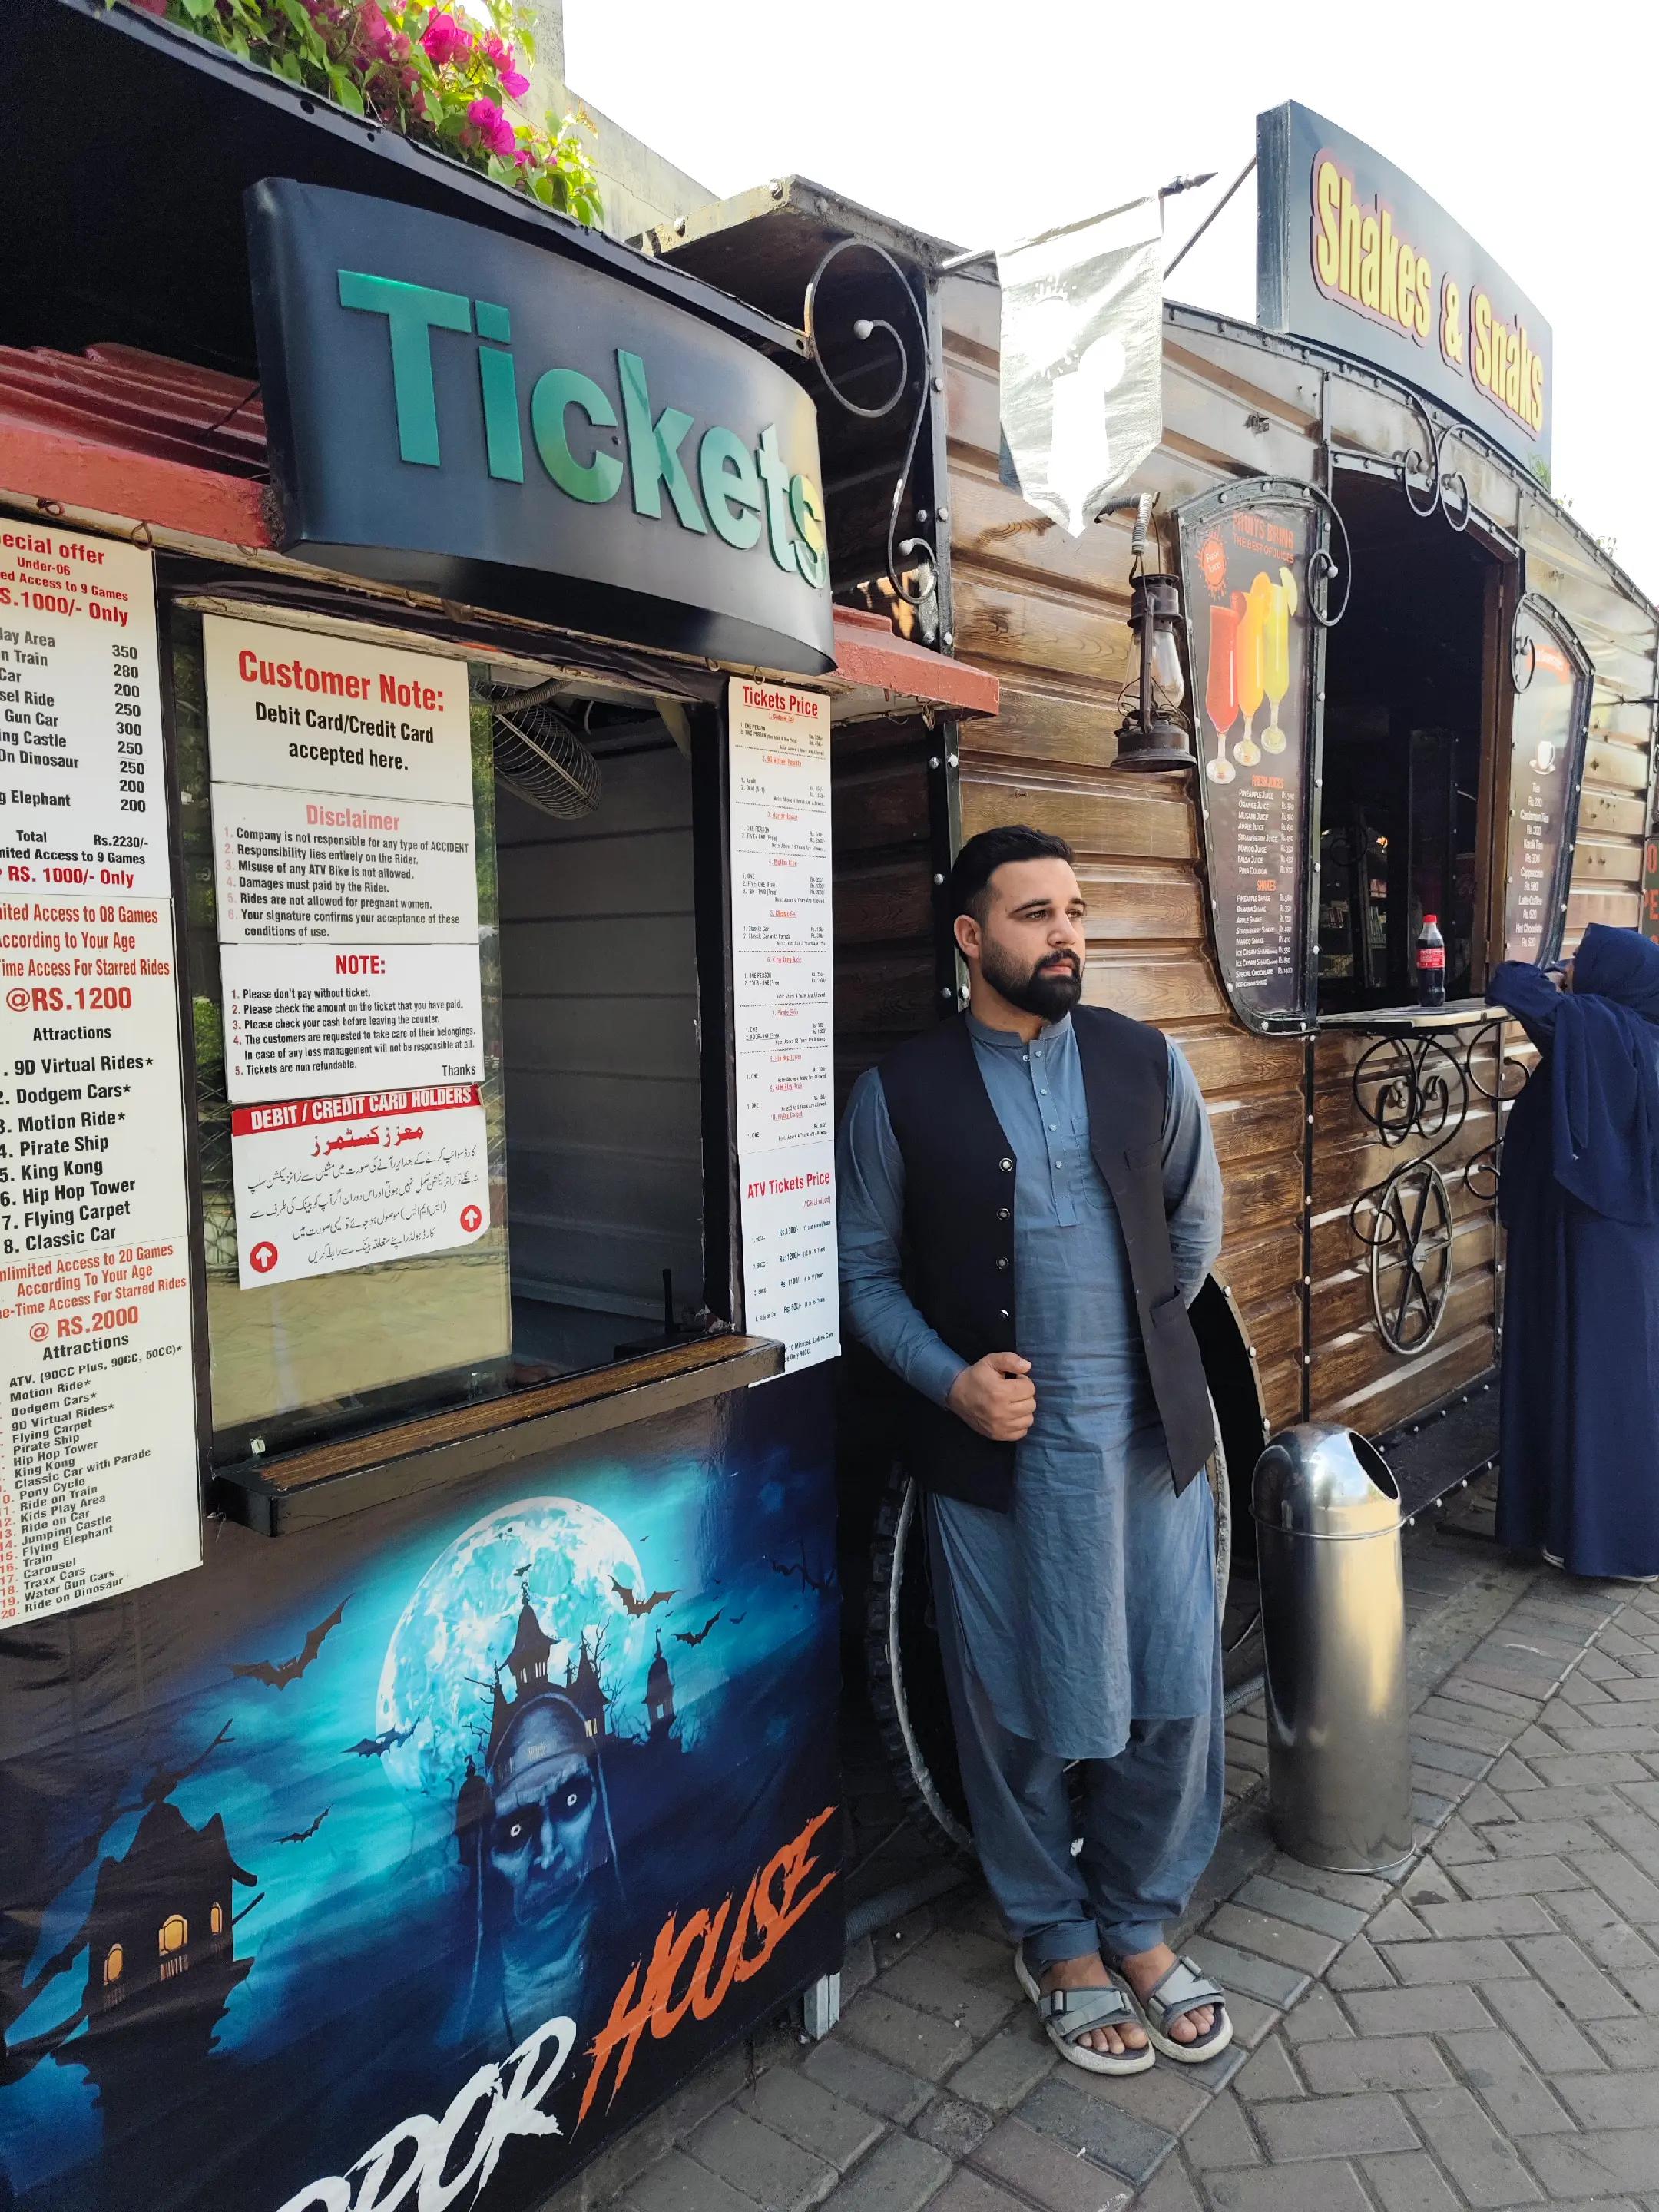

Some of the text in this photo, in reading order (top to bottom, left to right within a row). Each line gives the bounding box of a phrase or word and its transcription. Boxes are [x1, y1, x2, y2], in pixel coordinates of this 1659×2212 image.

[1316, 161, 1543, 432] Shakes & Snaks
[337, 269, 829, 590] Tickets
[0, 534, 104, 564] ecial offer
[18, 557, 70, 575] Under-06
[20, 573, 128, 601] Access to 9 Games
[0, 588, 127, 627] S.1000/- Only
[25, 631, 137, 660] Area 350
[14, 650, 138, 678] Train 280
[114, 684, 139, 697] 200
[239, 651, 443, 711] Customer Note:
[25, 691, 141, 717] Ride 250
[743, 686, 818, 717] Tickets Price
[5, 709, 141, 736] Gun Car 300
[256, 702, 433, 743] Debit Card/Credit Card
[24, 731, 143, 755] Castle 250
[20, 750, 144, 774] Dinosaur 250
[290, 743, 408, 770] accepted here.
[119, 780, 144, 793] 200
[11, 790, 145, 812] Elephant 200
[306, 805, 399, 830] Disclaimer
[16, 830, 147, 849] Total Rs.2230/-
[237, 844, 419, 865] Responsibility lies entirely on the Rider.
[8, 866, 134, 888] RS. 1000/- Only
[34, 904, 157, 923] Access to 08 Games
[240, 893, 432, 909] Rides are not allowed for pregnant women.
[65, 932, 135, 952] to Your Age
[245, 926, 330, 937] conditions of use.
[28, 959, 169, 977] Access For Starred Rides
[336, 955, 385, 974] NOTE:
[6, 987, 131, 1012] @RS.1200
[243, 988, 371, 1000] Please don't pay without ticket.
[34, 1027, 111, 1041] Attractions
[244, 1014, 440, 1030] Please check your cash before leaving the counter.
[247, 1060, 357, 1075] Tickets are non refundable.
[442, 1065, 476, 1076] Thanks
[251, 1087, 472, 1130] DEBIT / CREDIT CARD HOLDERS
[20, 1135, 108, 1156] Pirate Ship
[311, 1126, 423, 1157] معزز کسٹمرز
[22, 1161, 103, 1181] King Kong
[0, 1181, 135, 1207] 6. Hip Hop Tower
[747, 1171, 830, 1199] ATV Tickets Price
[2, 1201, 130, 1230] 7. Flying Carpet
[4, 1227, 115, 1253] 8. Classic Car
[57, 1245, 173, 1273] Access to 20 Games
[18, 1265, 152, 1297] According To Your Age
[49, 1278, 186, 1310] Access For Starred Rides
[30, 1306, 138, 1342] @ RS.2000
[43, 1335, 129, 1360] Attractions
[19, 1477, 85, 1500] Pony Cycle
[23, 1558, 76, 1579] Carousel
[25, 1578, 123, 1613] Ride on Dinosaur
[568, 1804, 840, 2144] HOUSE
